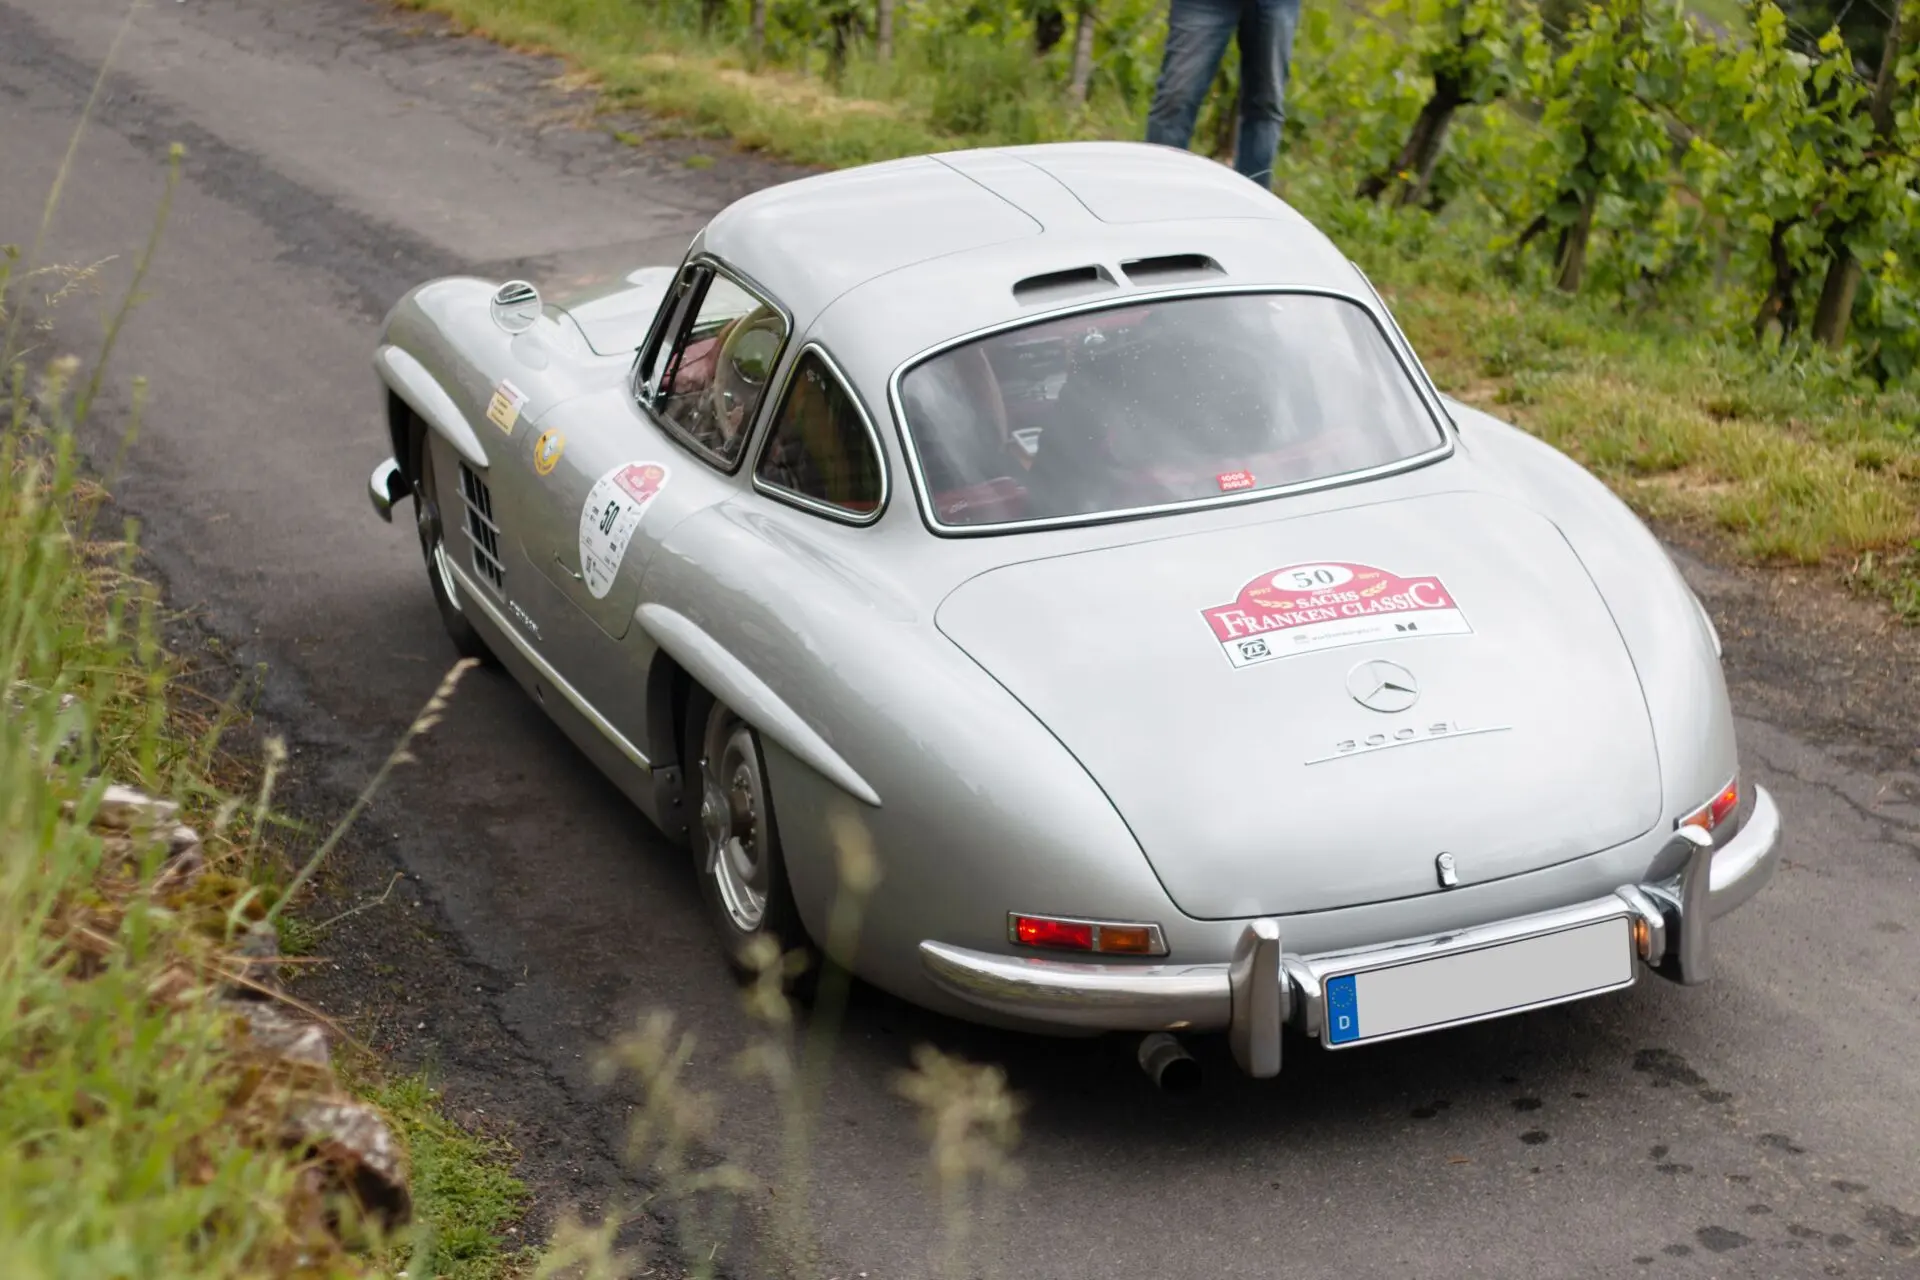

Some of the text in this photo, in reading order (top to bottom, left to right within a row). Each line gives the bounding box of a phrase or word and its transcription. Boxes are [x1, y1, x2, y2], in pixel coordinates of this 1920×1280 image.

[599, 500, 621, 537] 50
[1292, 569, 1334, 588] 50
[1214, 609, 1337, 638] FRANKEN
[1341, 582, 1446, 615] CLASSIC
[1295, 590, 1359, 609] SACHS
[1336, 727, 1415, 753] 300
[1338, 1015, 1351, 1031] D
